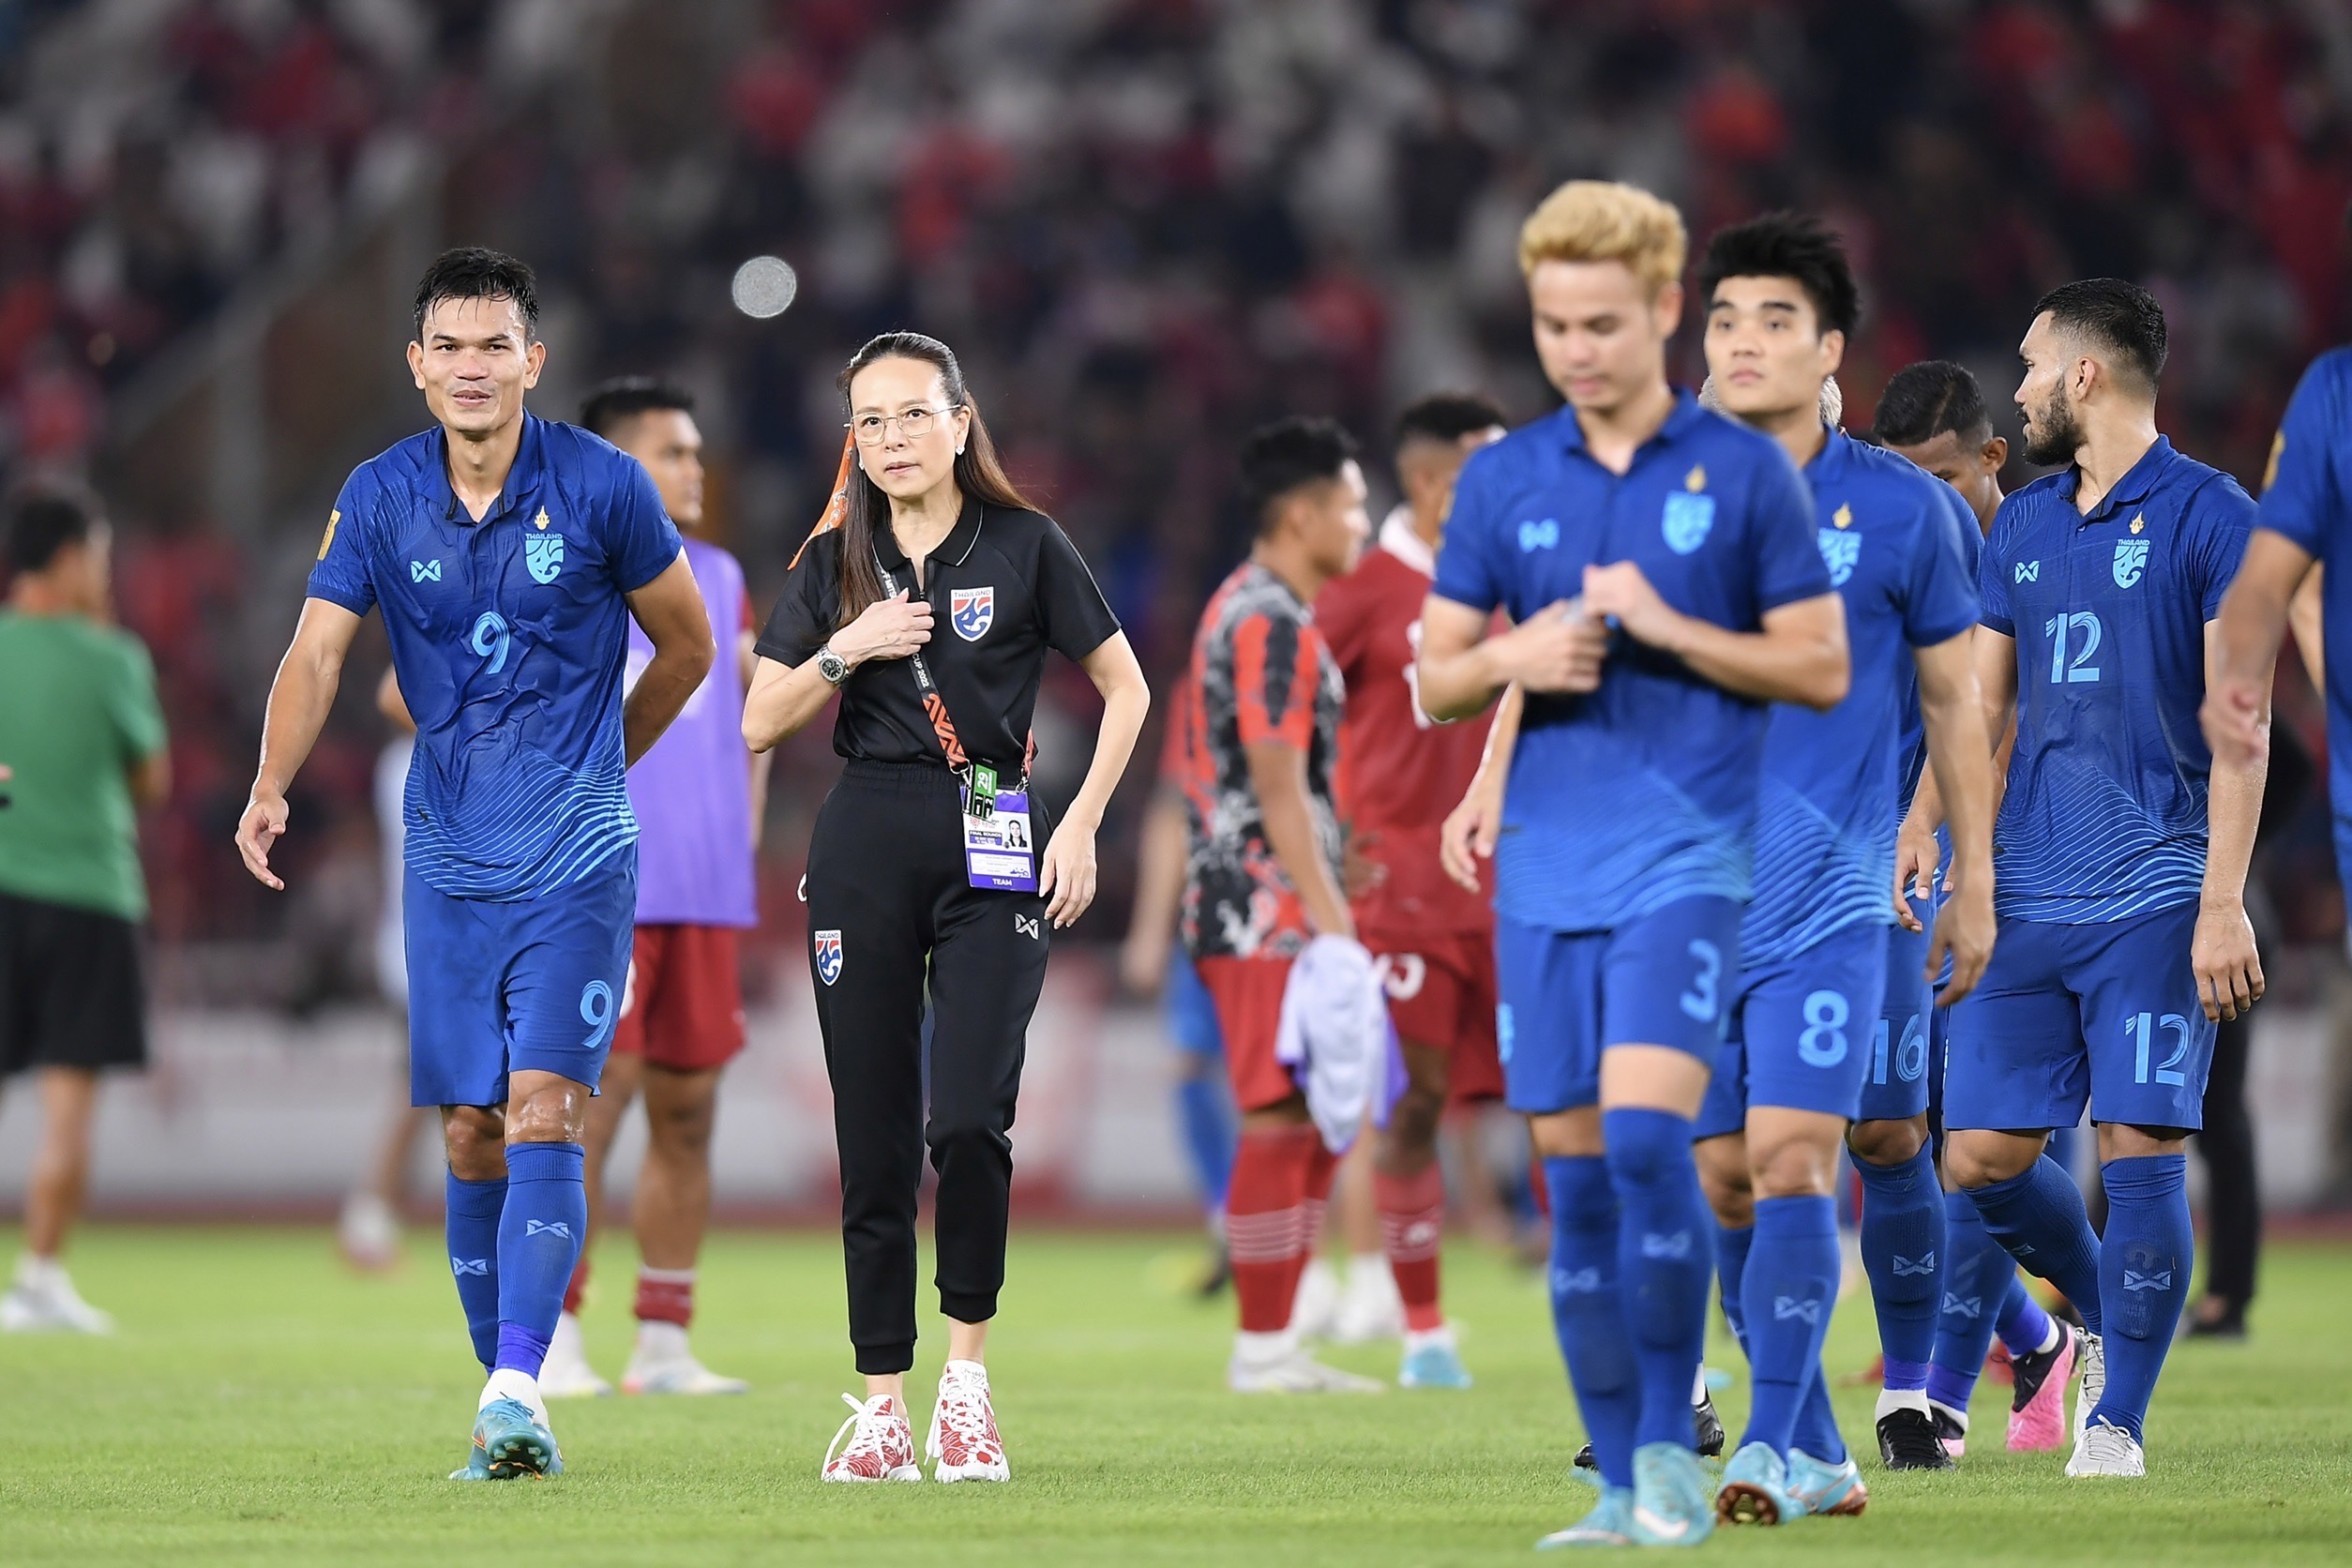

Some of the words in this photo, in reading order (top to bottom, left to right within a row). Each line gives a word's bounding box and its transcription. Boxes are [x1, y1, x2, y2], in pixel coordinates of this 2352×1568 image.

[954, 590, 991, 598] THAILAND
[472, 611, 510, 675] 9
[912, 653, 923, 669] CUP
[2045, 611, 2102, 684] 12
[917, 669, 929, 688] 2022
[977, 771, 988, 790] 29
[992, 878, 1012, 886] TEAM
[1680, 938, 1723, 1022] 3
[580, 980, 612, 1048] 9
[1798, 989, 1849, 1068] 8
[1873, 1012, 1925, 1085] 16
[2124, 1012, 2190, 1087] 12
